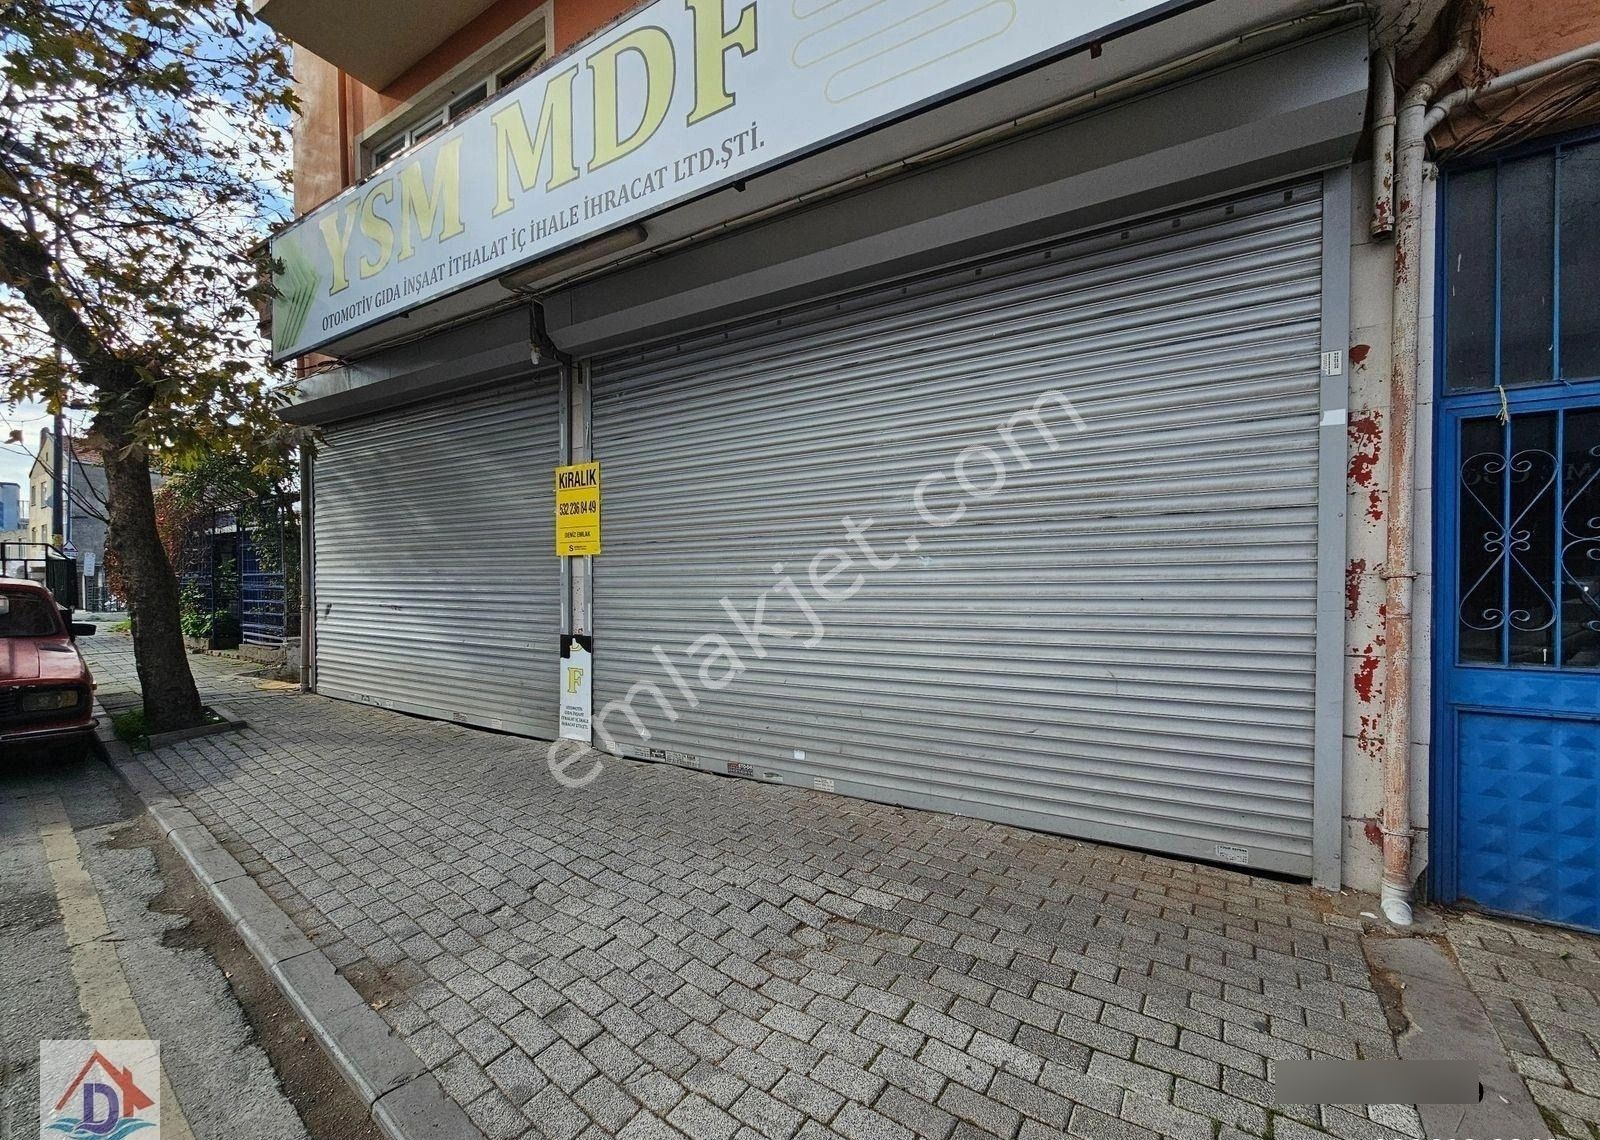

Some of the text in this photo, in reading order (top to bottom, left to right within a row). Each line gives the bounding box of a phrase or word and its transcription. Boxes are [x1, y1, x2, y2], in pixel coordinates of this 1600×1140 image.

[319, 0, 758, 296] YSM MDF
[322, 121, 765, 332] OTOMOTİV GIDA İNŞAAT İTHALAT İÇ İHALE İHRACAT LTD.ŞTİ.
[560, 500, 597, 516] 532 236 84 49
[567, 667, 583, 694] F
